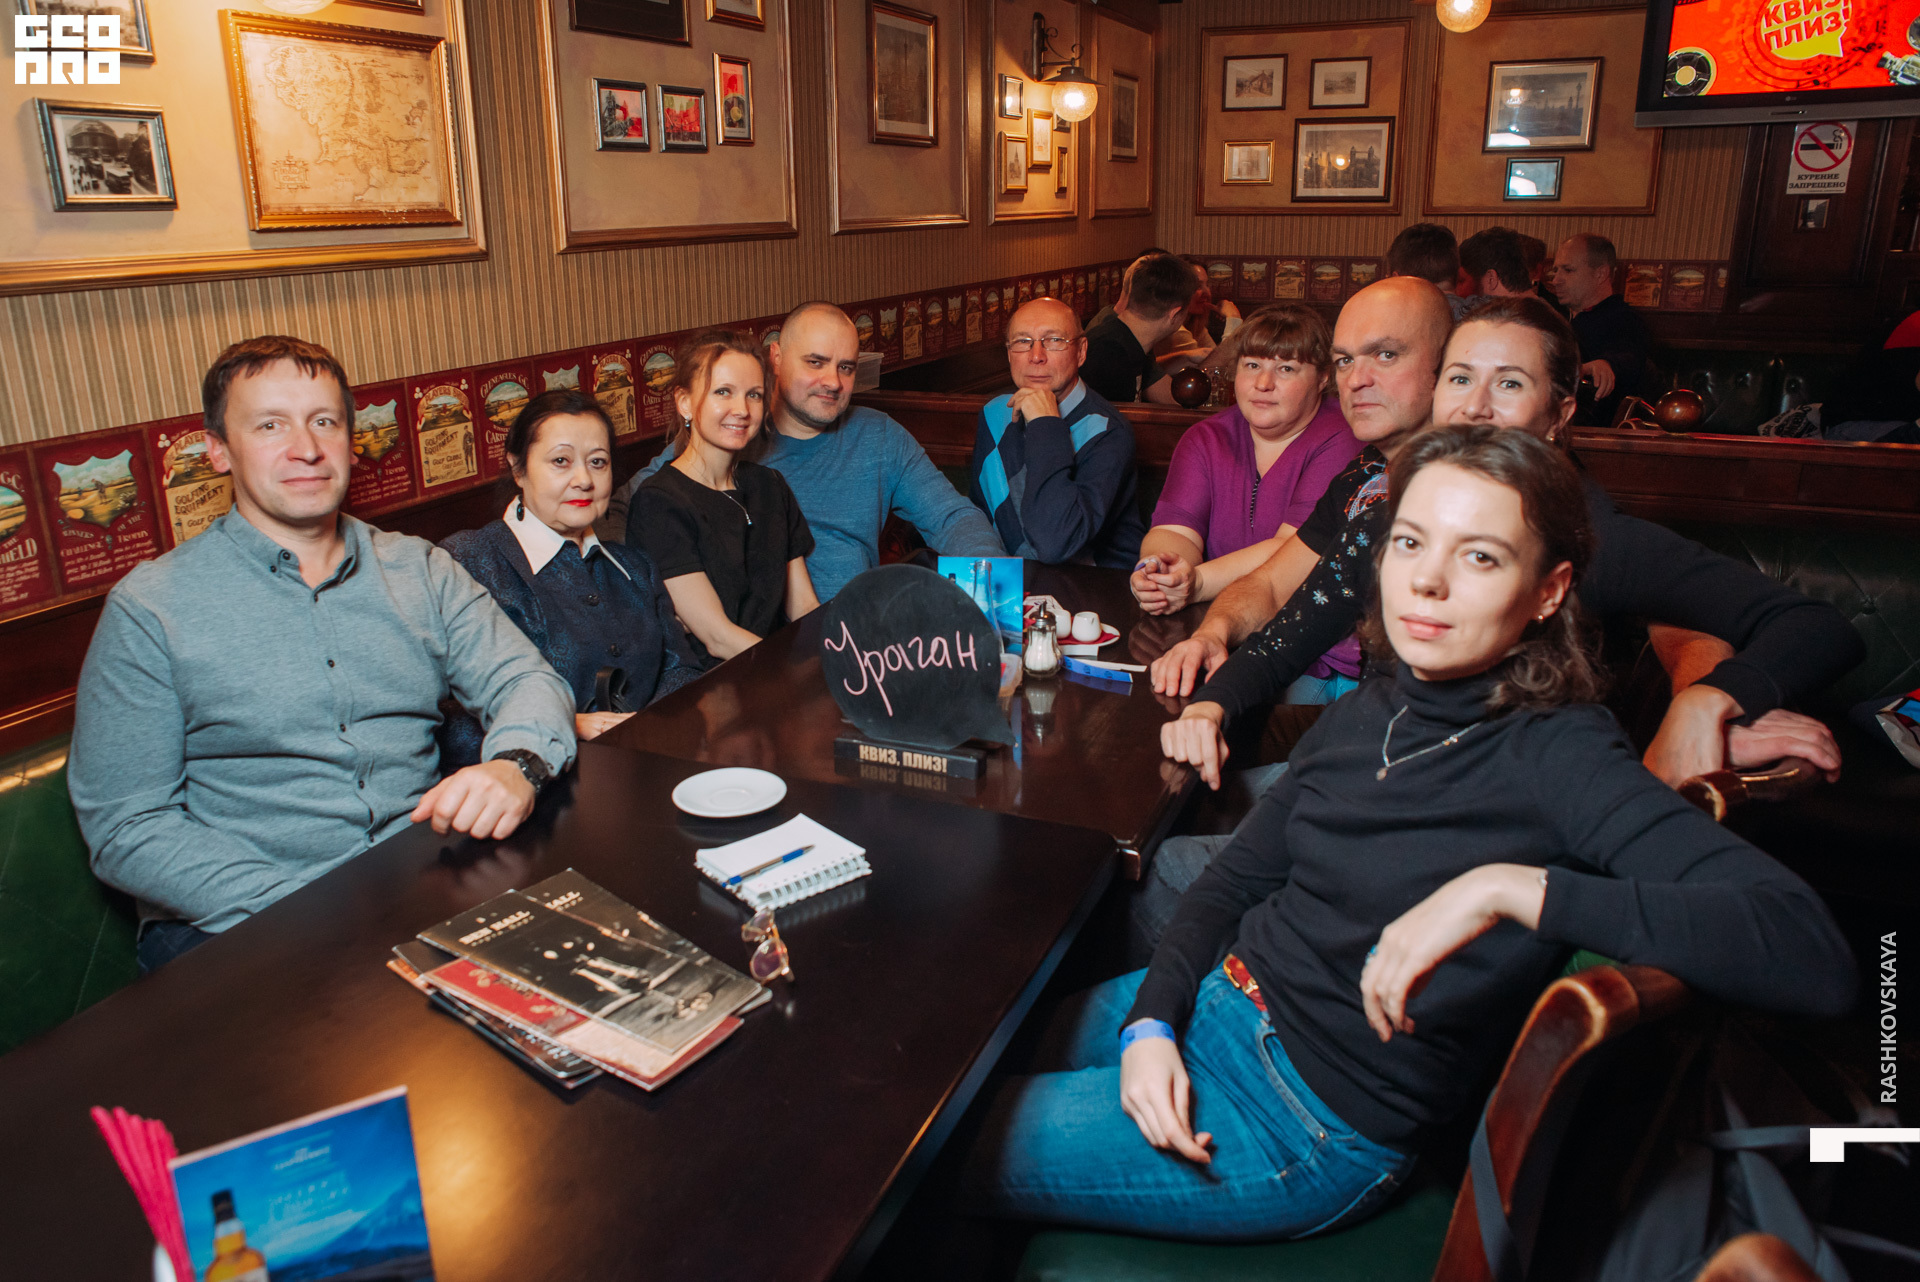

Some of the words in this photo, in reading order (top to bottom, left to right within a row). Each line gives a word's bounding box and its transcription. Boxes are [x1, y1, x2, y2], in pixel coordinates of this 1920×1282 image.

[1764, 8, 1850, 49] ПЛИЗ!
[1788, 181, 1846, 189] ЗАПРЕЩЕНО
[1797, 173, 1840, 181] КУРЕНИЕ
[174, 484, 224, 515] EQUIPMENT
[175, 482, 210, 505] GOLFING
[187, 517, 205, 528] GOLF
[824, 620, 978, 718] Ураган
[858, 744, 900, 767] КВИЗ,
[902, 751, 948, 773] ПЛИЗ!
